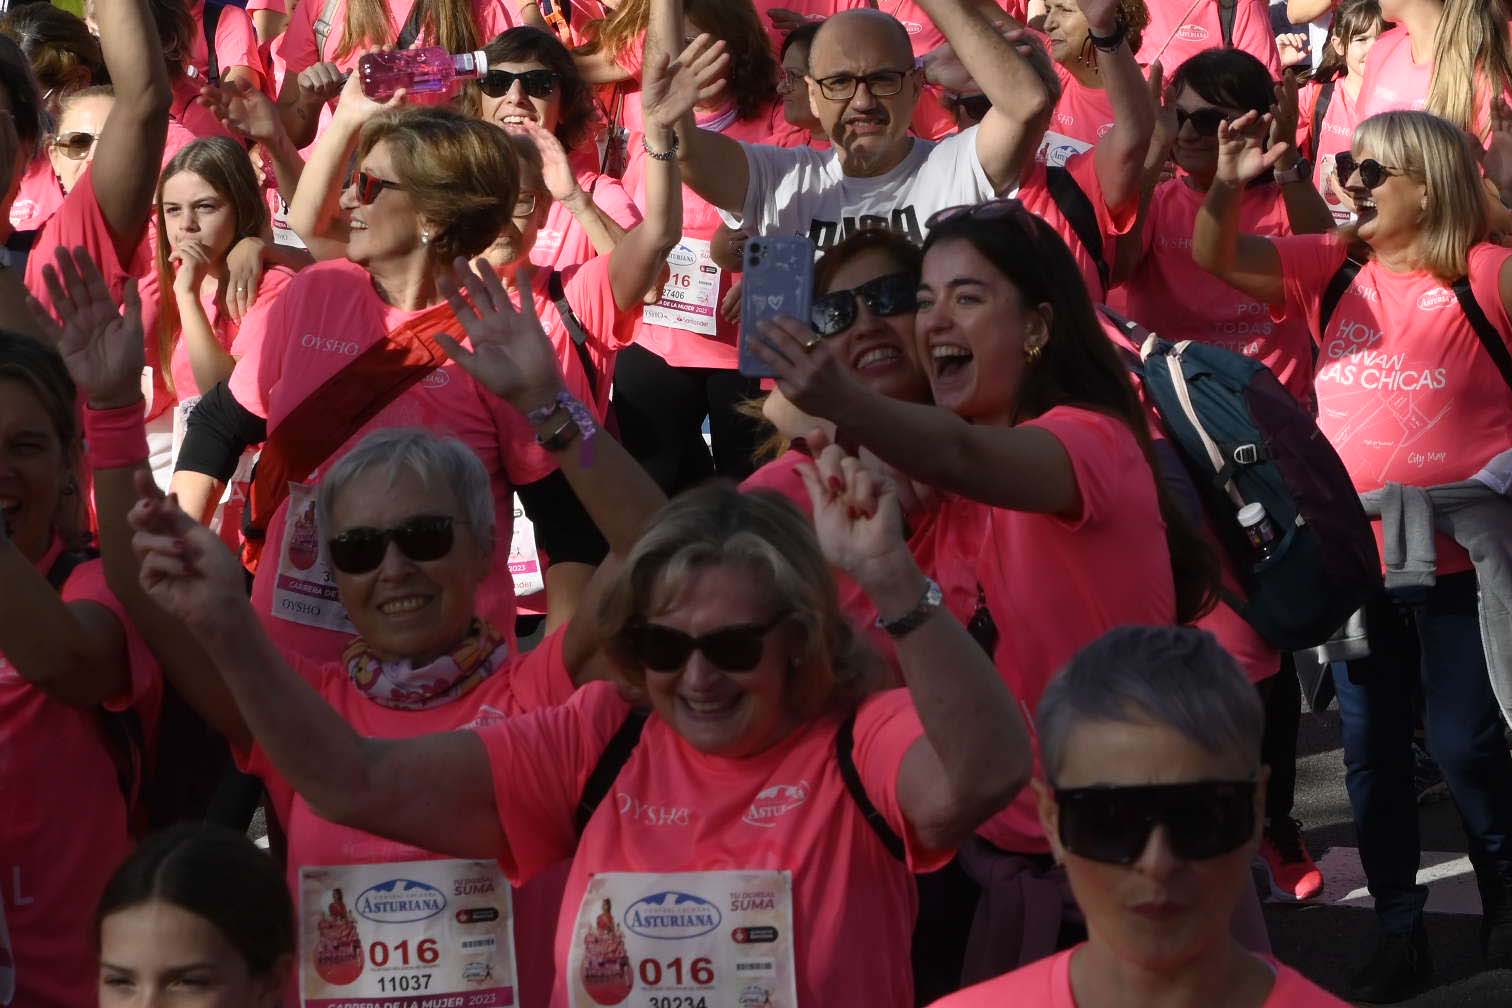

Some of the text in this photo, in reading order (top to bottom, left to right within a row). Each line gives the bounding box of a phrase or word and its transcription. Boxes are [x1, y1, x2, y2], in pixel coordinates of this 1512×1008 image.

[1335, 319, 1381, 344] HOY
[1327, 338, 1406, 370] GANAN
[1360, 367, 1447, 391] CHICAS
[282, 598, 320, 616] OYSHO
[453, 884, 496, 896] SUMA
[363, 898, 440, 914] ASTURIANA
[730, 899, 774, 912] SUMA
[631, 910, 714, 928] ASTURIANA
[369, 938, 440, 967] 016
[639, 957, 715, 985] 016
[378, 974, 432, 993] 11037
[421, 997, 465, 1008] MUJER
[469, 993, 497, 1004] 2023
